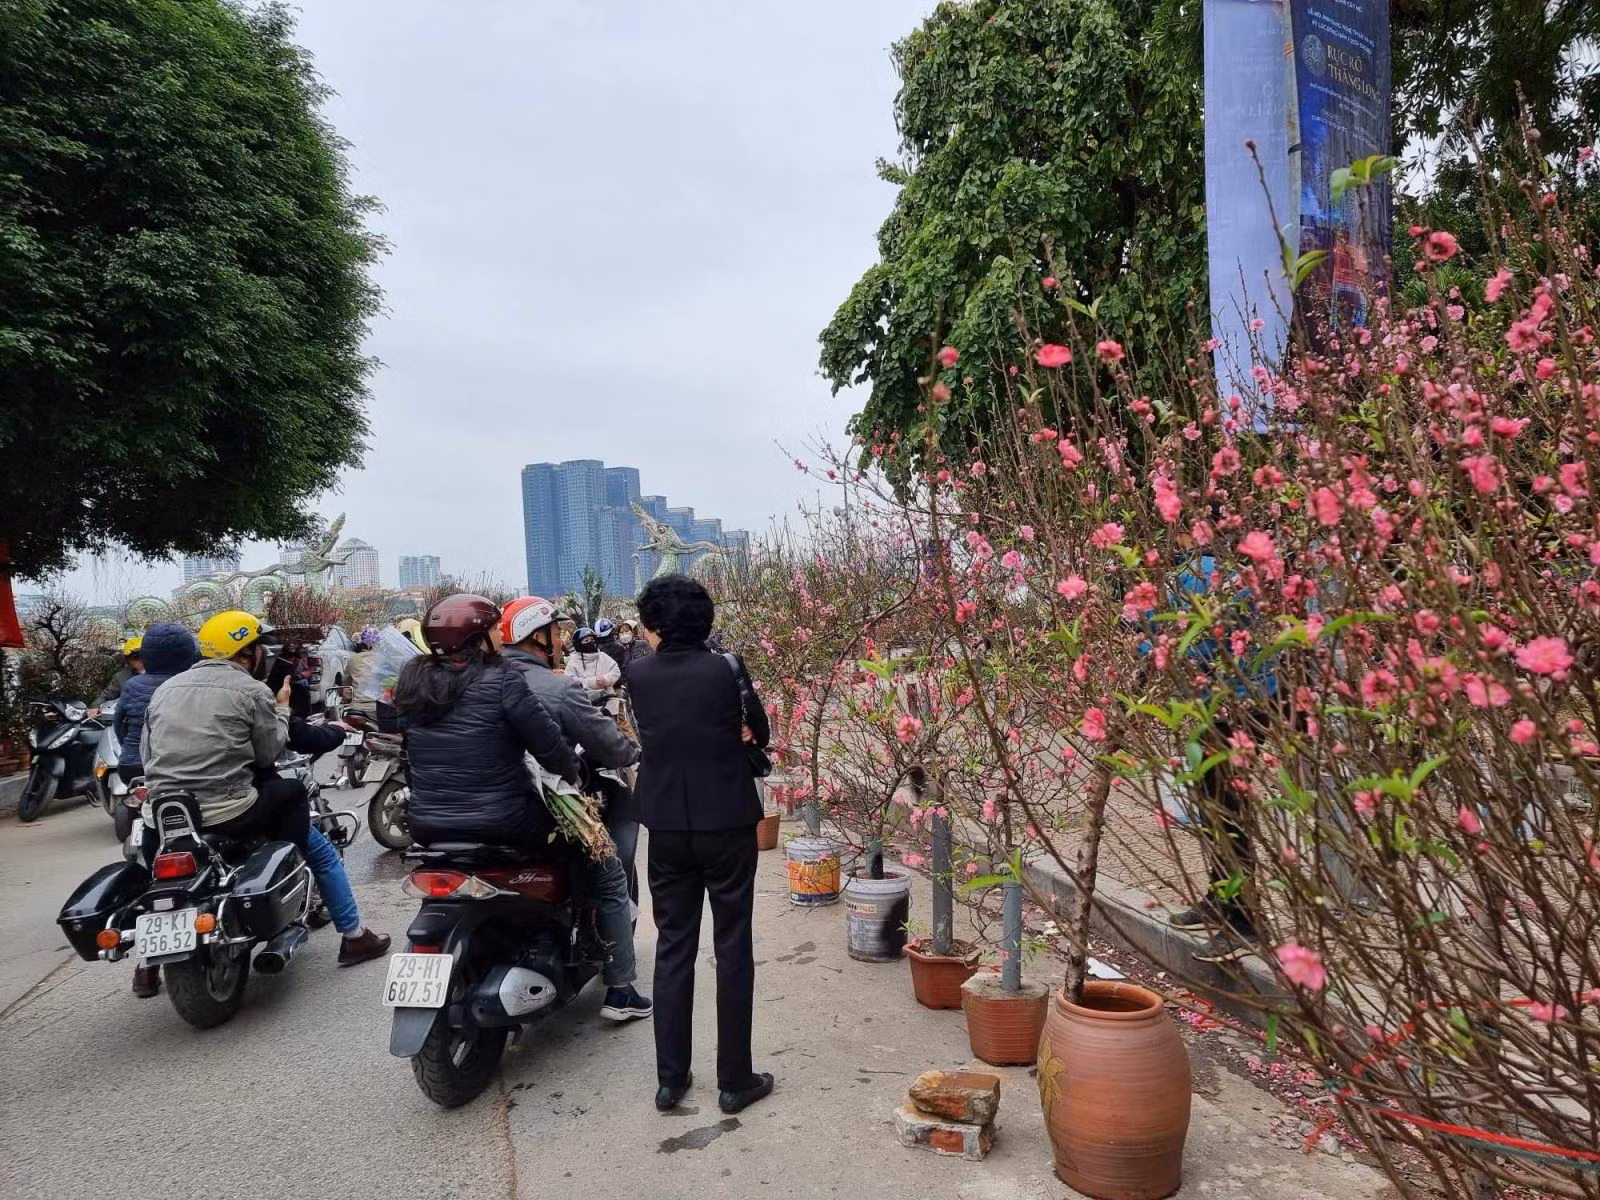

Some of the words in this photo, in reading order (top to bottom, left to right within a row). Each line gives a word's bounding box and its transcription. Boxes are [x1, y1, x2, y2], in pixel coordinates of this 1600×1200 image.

[145, 912, 187, 935] 29-K1
[139, 930, 192, 955] 356.52
[396, 957, 442, 979] 29-H1
[387, 981, 442, 1004] 687.51
